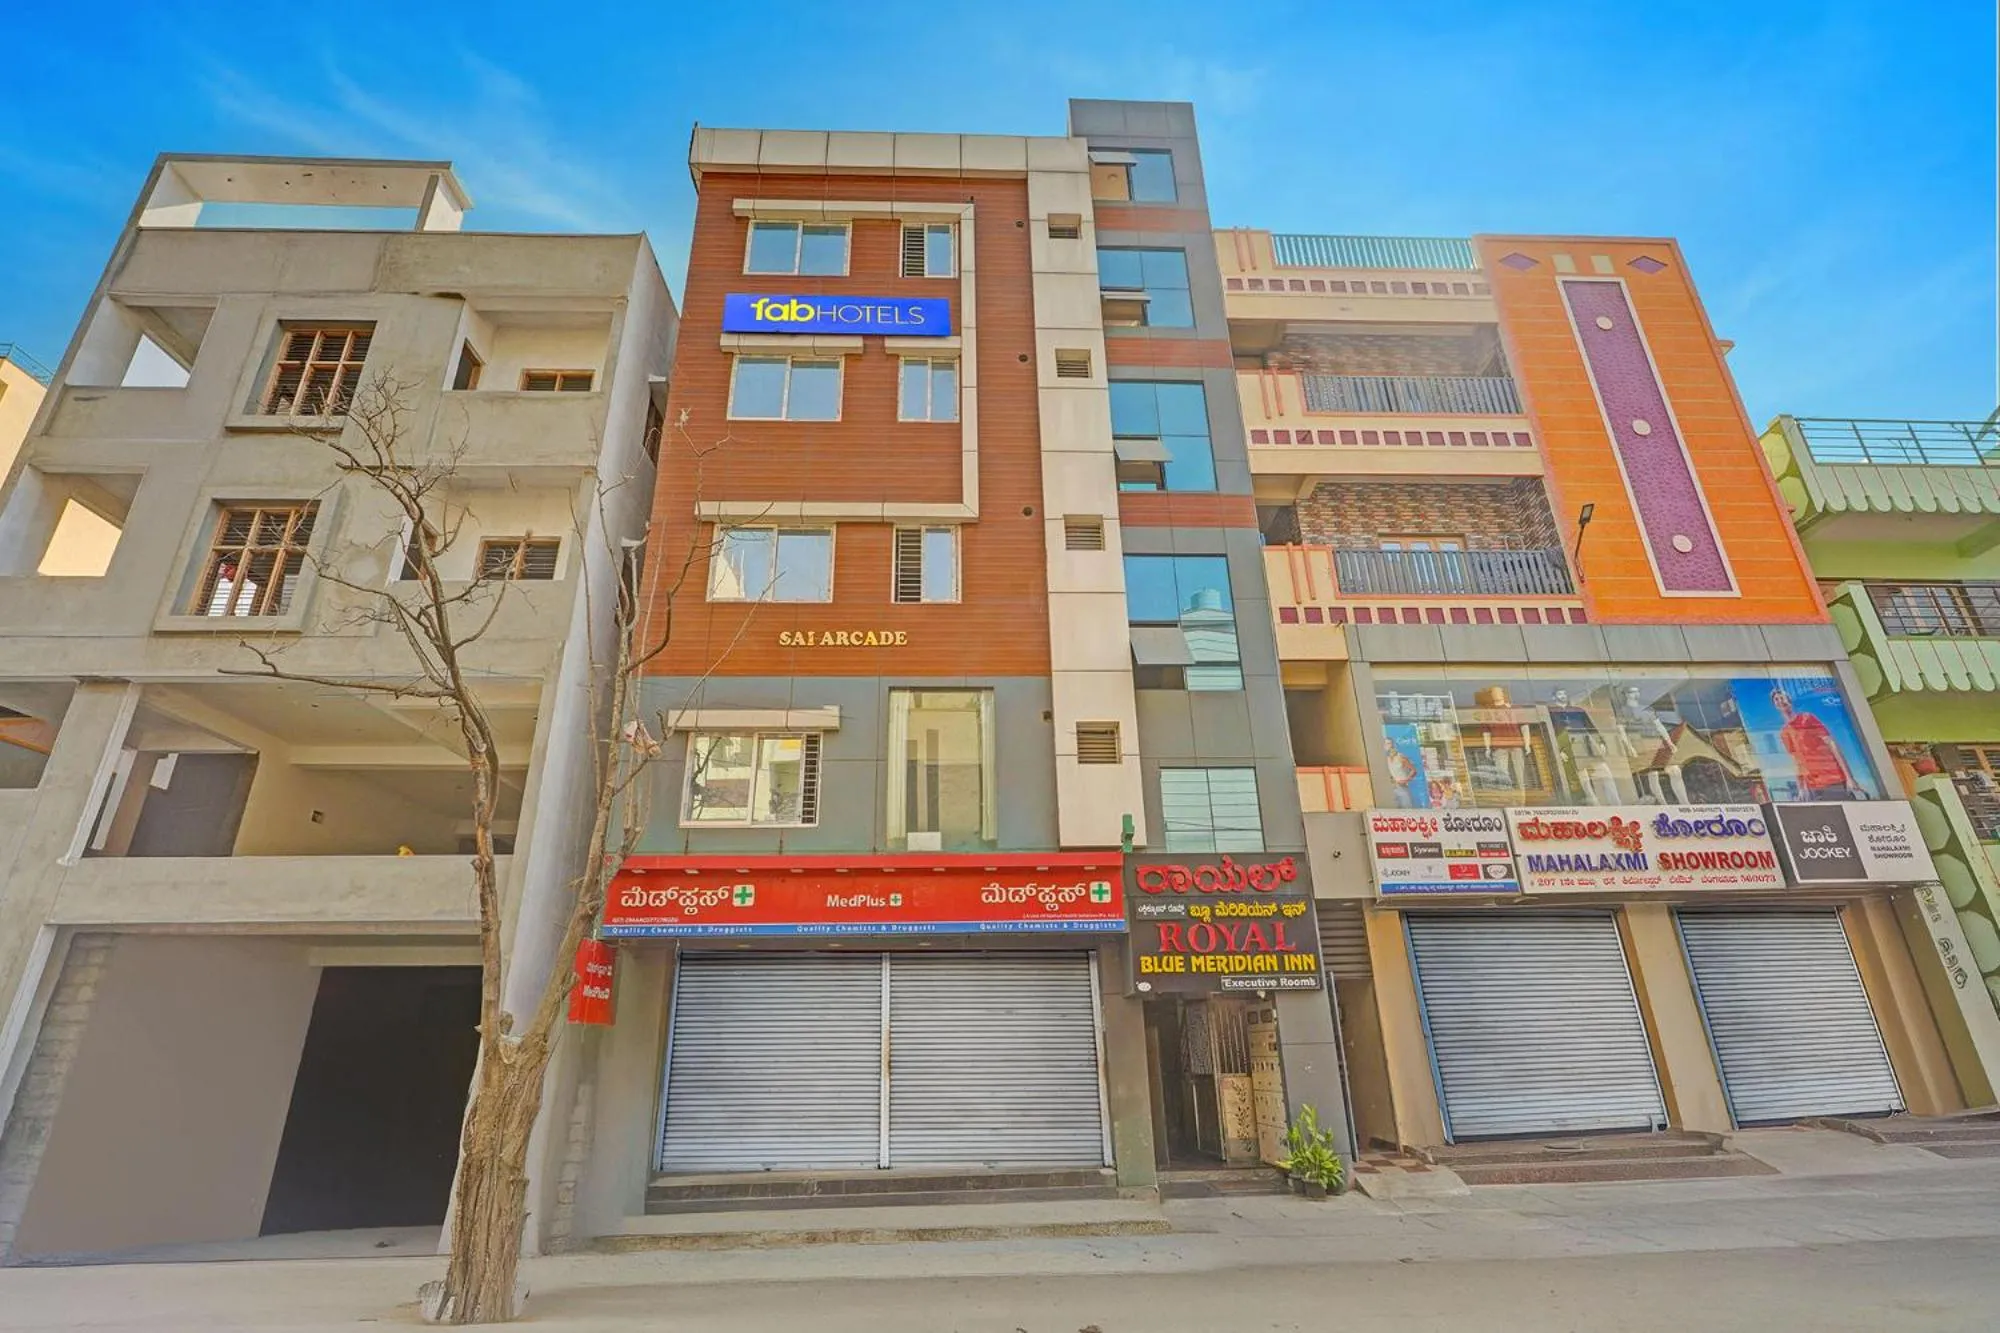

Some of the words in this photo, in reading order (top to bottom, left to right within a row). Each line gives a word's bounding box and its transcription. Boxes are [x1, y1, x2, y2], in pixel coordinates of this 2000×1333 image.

[750, 297, 925, 325] fabHOTELS
[779, 630, 815, 646] SAI
[820, 630, 908, 646] ARCADE
[1799, 847, 1851, 860] JOCKEY
[1526, 852, 1649, 873] MAHALAXMI
[1657, 850, 1775, 871] SHOWROOM
[1537, 877, 1555, 886] 207
[826, 893, 886, 908] MedPlus
[612, 926, 646, 935] Quality
[651, 926, 692, 934] Chemists
[707, 925, 753, 934] Druggists
[797, 925, 831, 933] Quality
[892, 924, 936, 932] Druggists
[980, 923, 1013, 931] Quality
[1073, 921, 1117, 930] Druggists
[1155, 921, 1296, 953] ROYAL
[1139, 954, 1185, 974] BLUE
[1191, 953, 1279, 974] MERIDIAN
[1283, 952, 1316, 972] INN
[1224, 977, 1277, 988] Executive
[1280, 976, 1316, 987] Rooms
